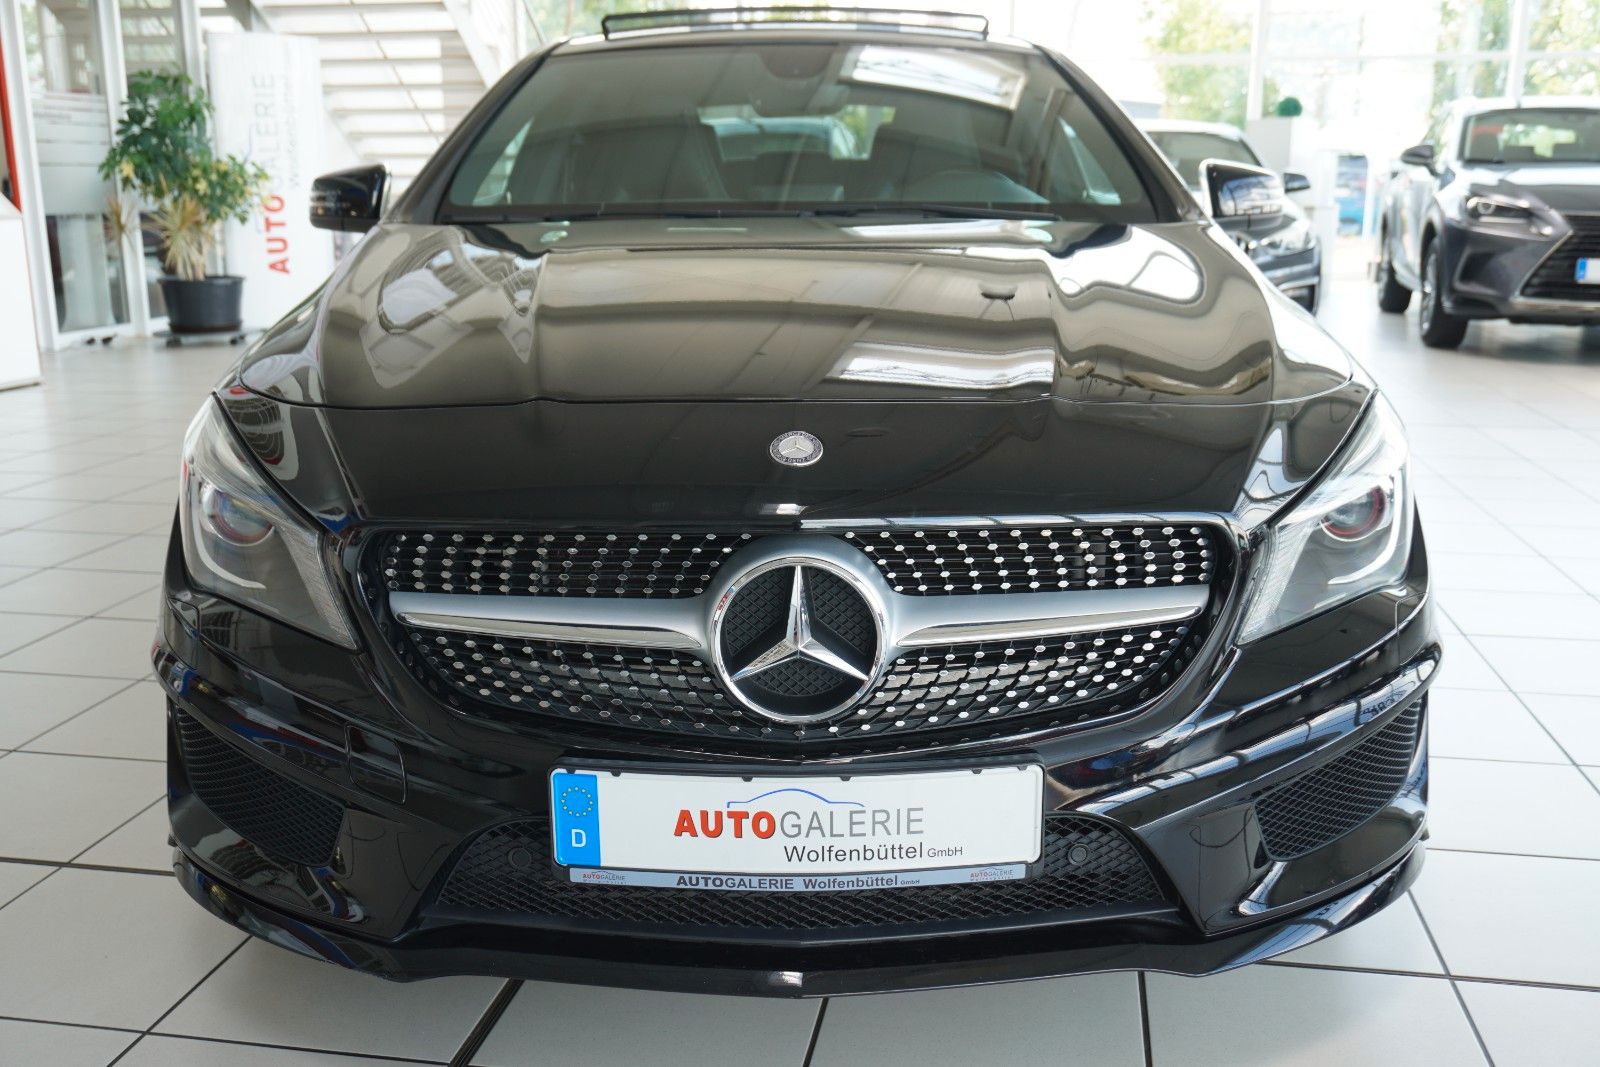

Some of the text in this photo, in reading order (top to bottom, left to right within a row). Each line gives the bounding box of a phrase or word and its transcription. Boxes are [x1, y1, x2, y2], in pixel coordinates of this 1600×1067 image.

[673, 807, 924, 839] AUTOGALERIE
[571, 828, 587, 847] D
[784, 842, 963, 863] Wolfenbüttel GmbH
[676, 875, 794, 890] AUTOGALERIE
[803, 875, 898, 890] Wolfenbüttel
